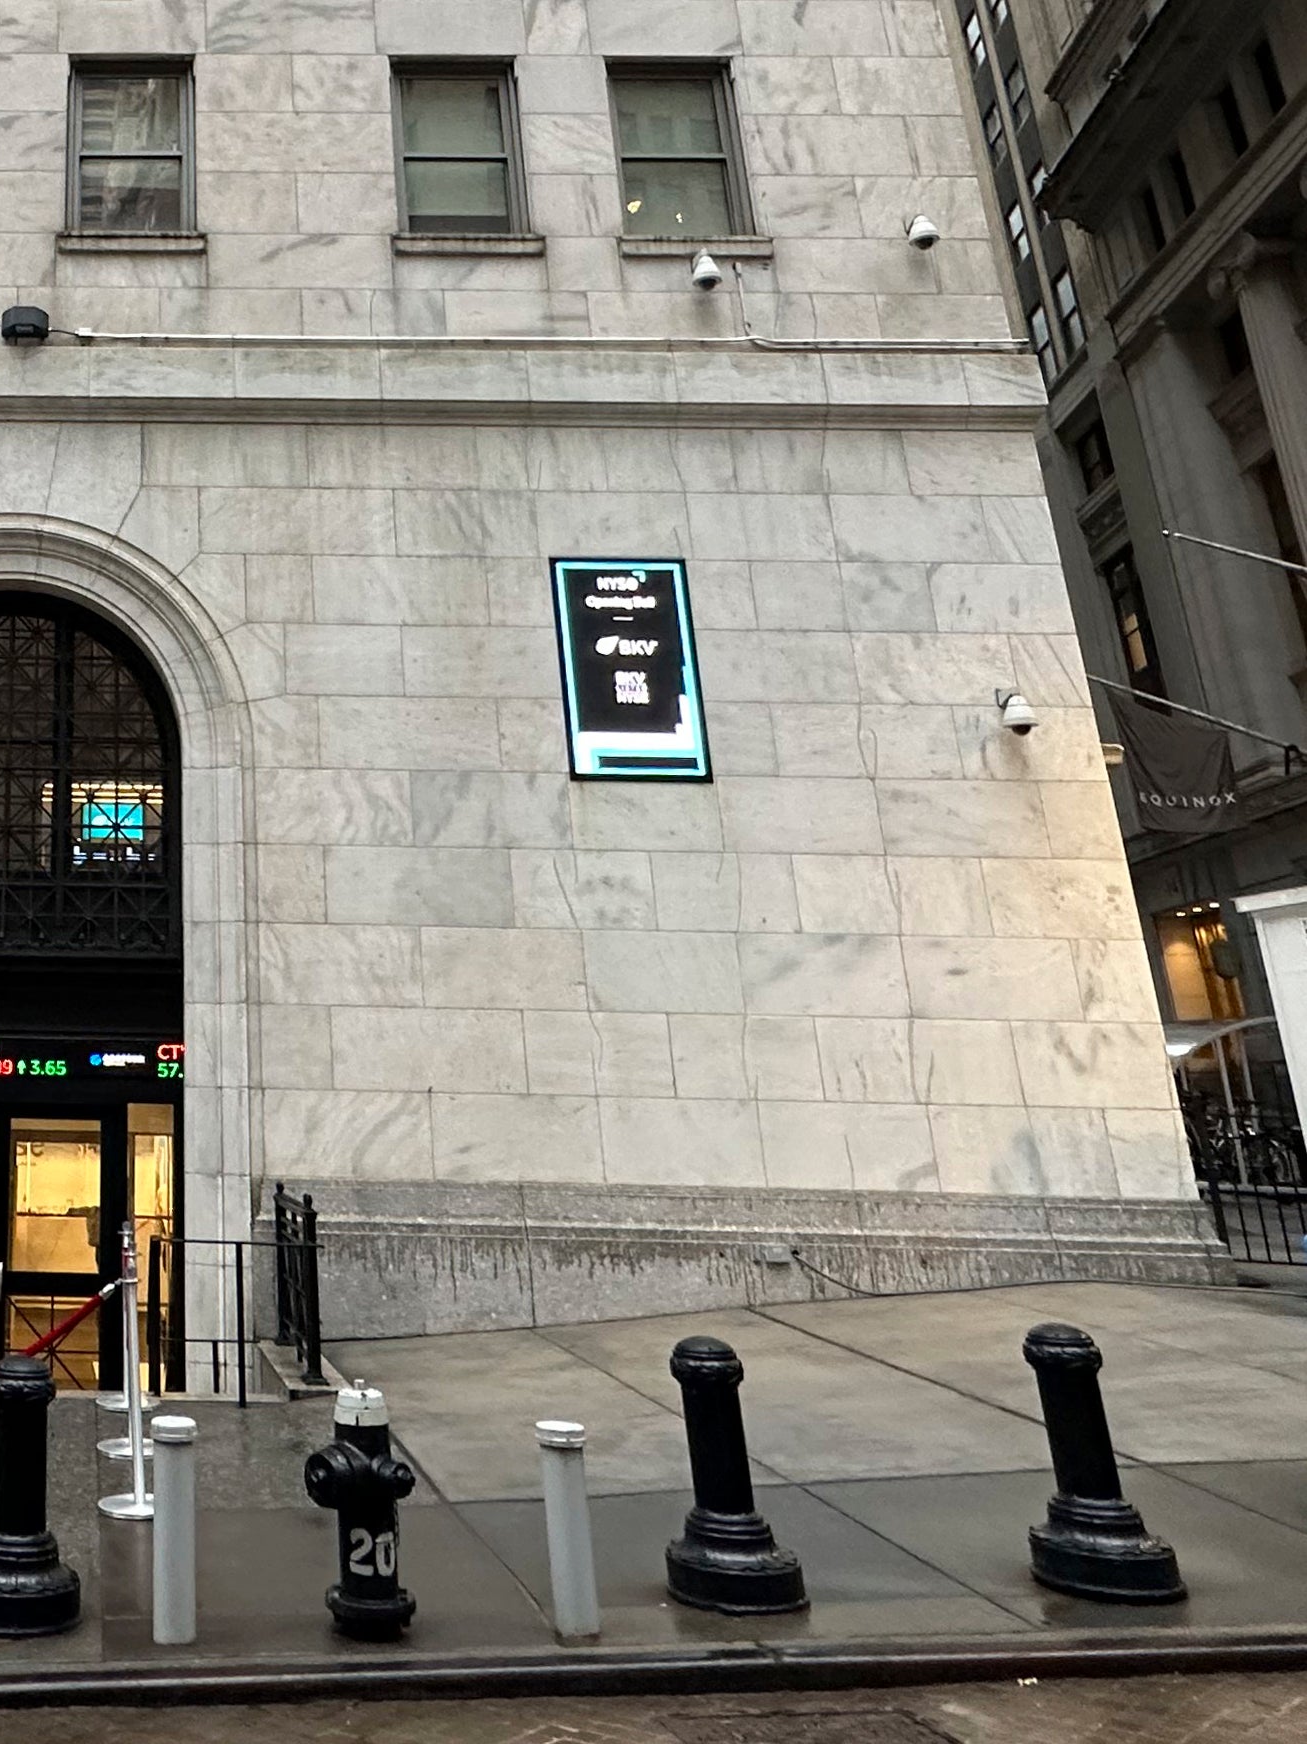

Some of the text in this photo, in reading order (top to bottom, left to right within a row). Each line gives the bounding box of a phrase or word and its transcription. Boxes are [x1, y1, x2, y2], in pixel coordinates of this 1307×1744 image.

[618, 639, 658, 656] BKV
[1139, 791, 1237, 808] EQUINOX
[29, 1059, 67, 1076] 3.65
[349, 1527, 396, 1577] 20
